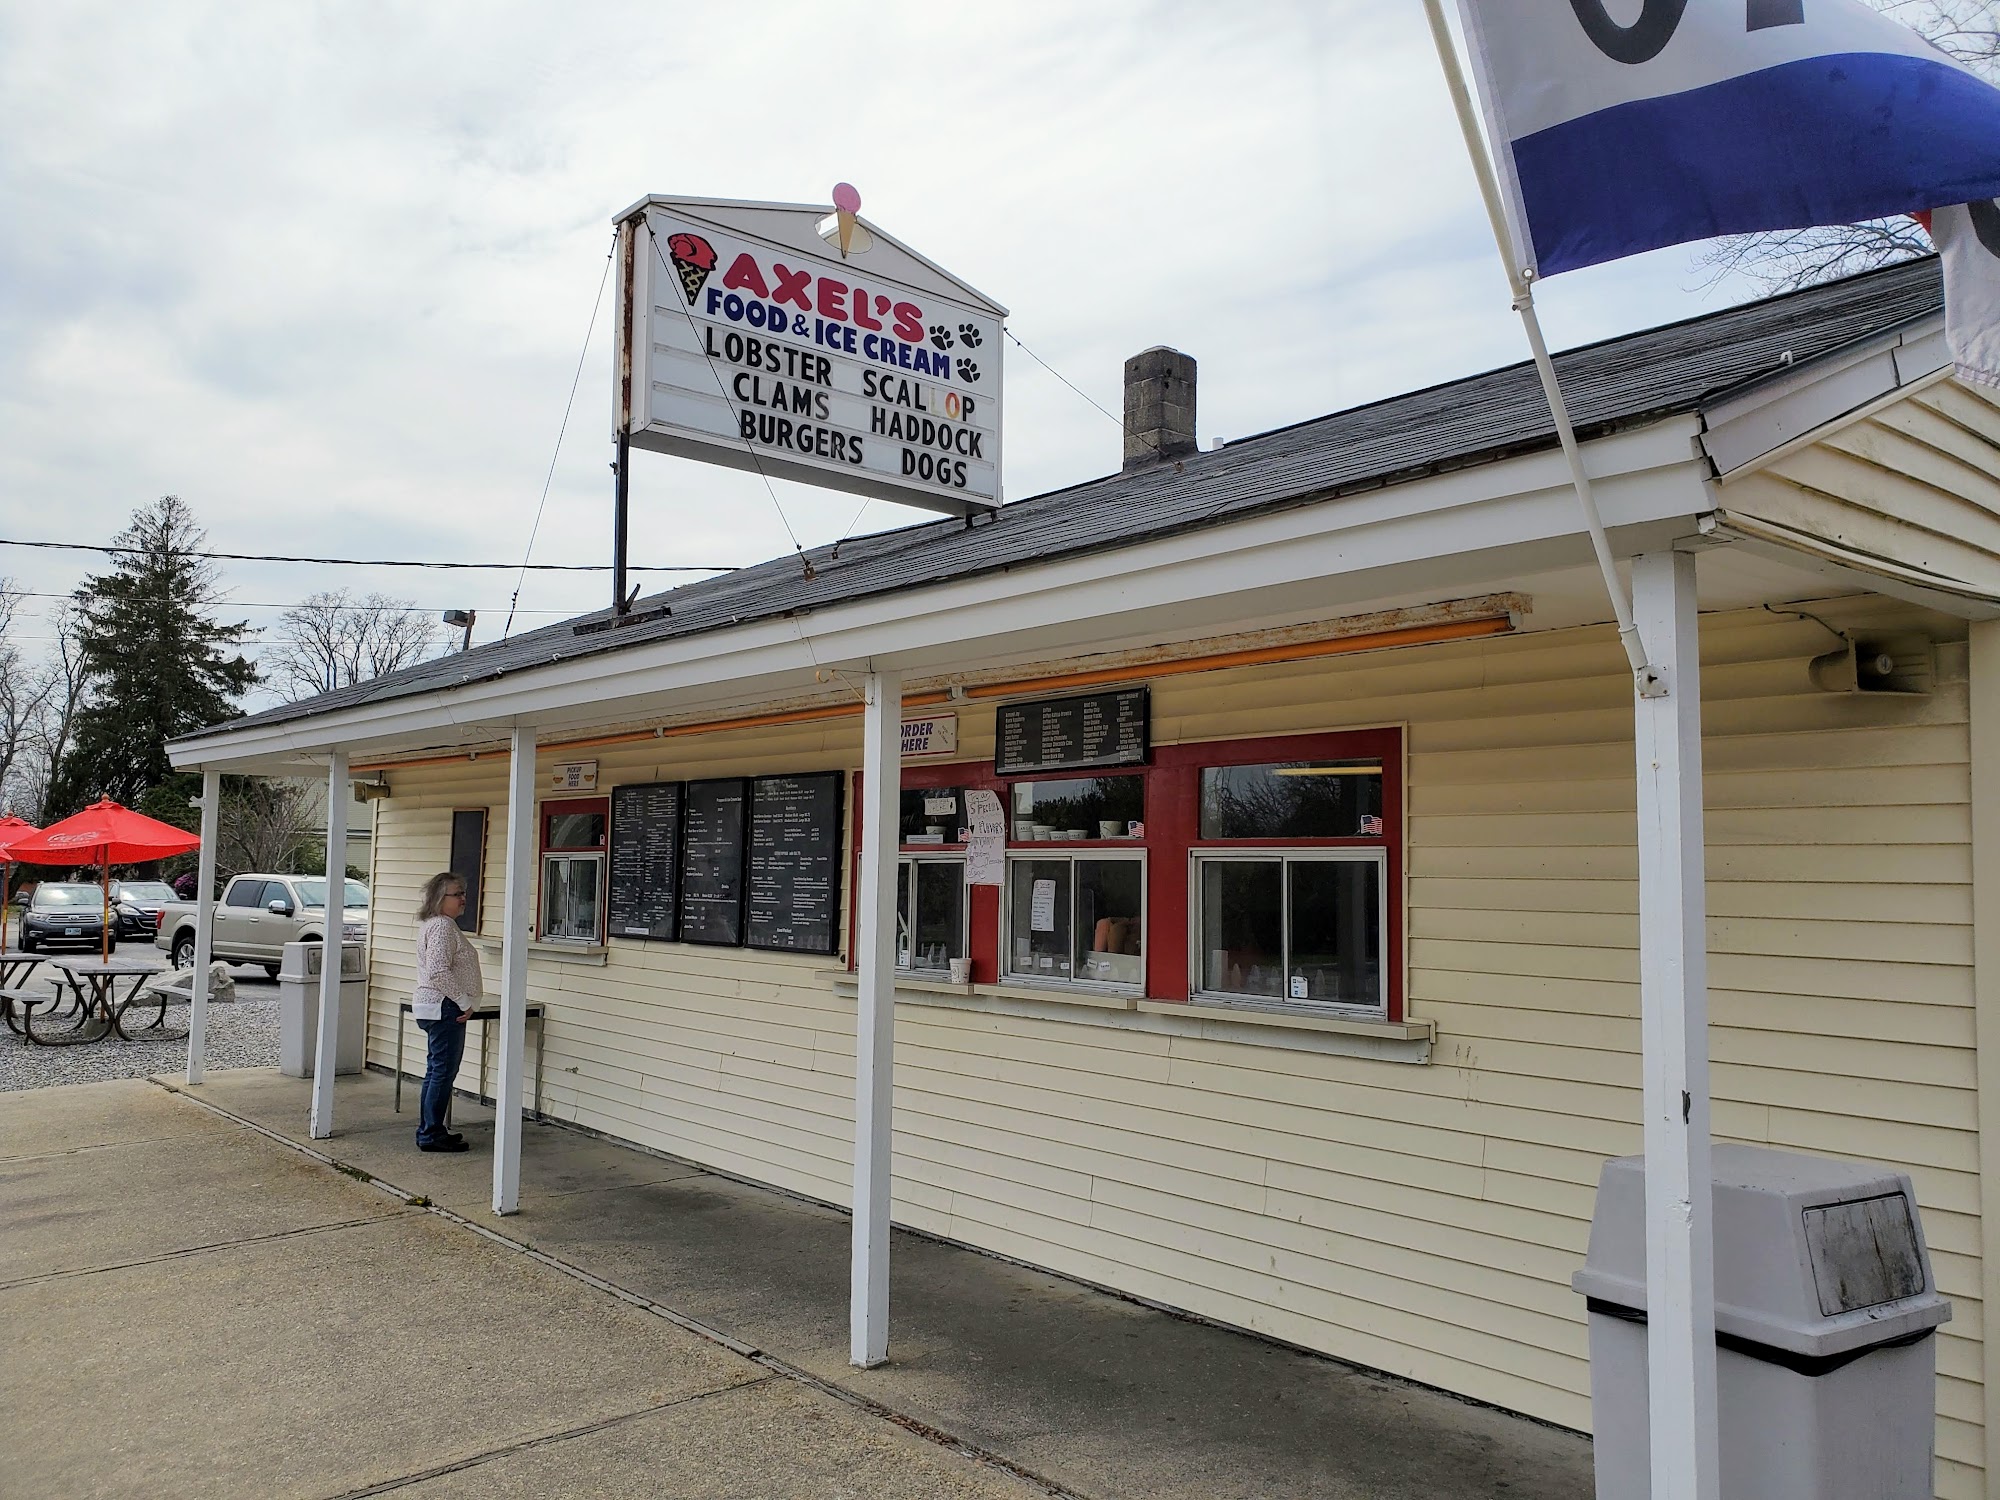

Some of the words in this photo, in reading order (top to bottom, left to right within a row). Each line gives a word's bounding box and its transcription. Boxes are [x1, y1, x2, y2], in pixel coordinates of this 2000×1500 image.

[707, 287, 788, 333] FOOD
[792, 314, 810, 338] &
[815, 318, 857, 354] ICE
[863, 334, 950, 380] CREAM
[723, 253, 925, 343] AXEL'S
[706, 326, 832, 387] LOBSTER
[733, 372, 829, 420] CLAMS
[872, 406, 982, 458] HADDOCK
[740, 409, 863, 464] BURGERS
[902, 448, 967, 488] DOGS
[901, 722, 934, 738] RDER
[901, 737, 929, 752] HERE
